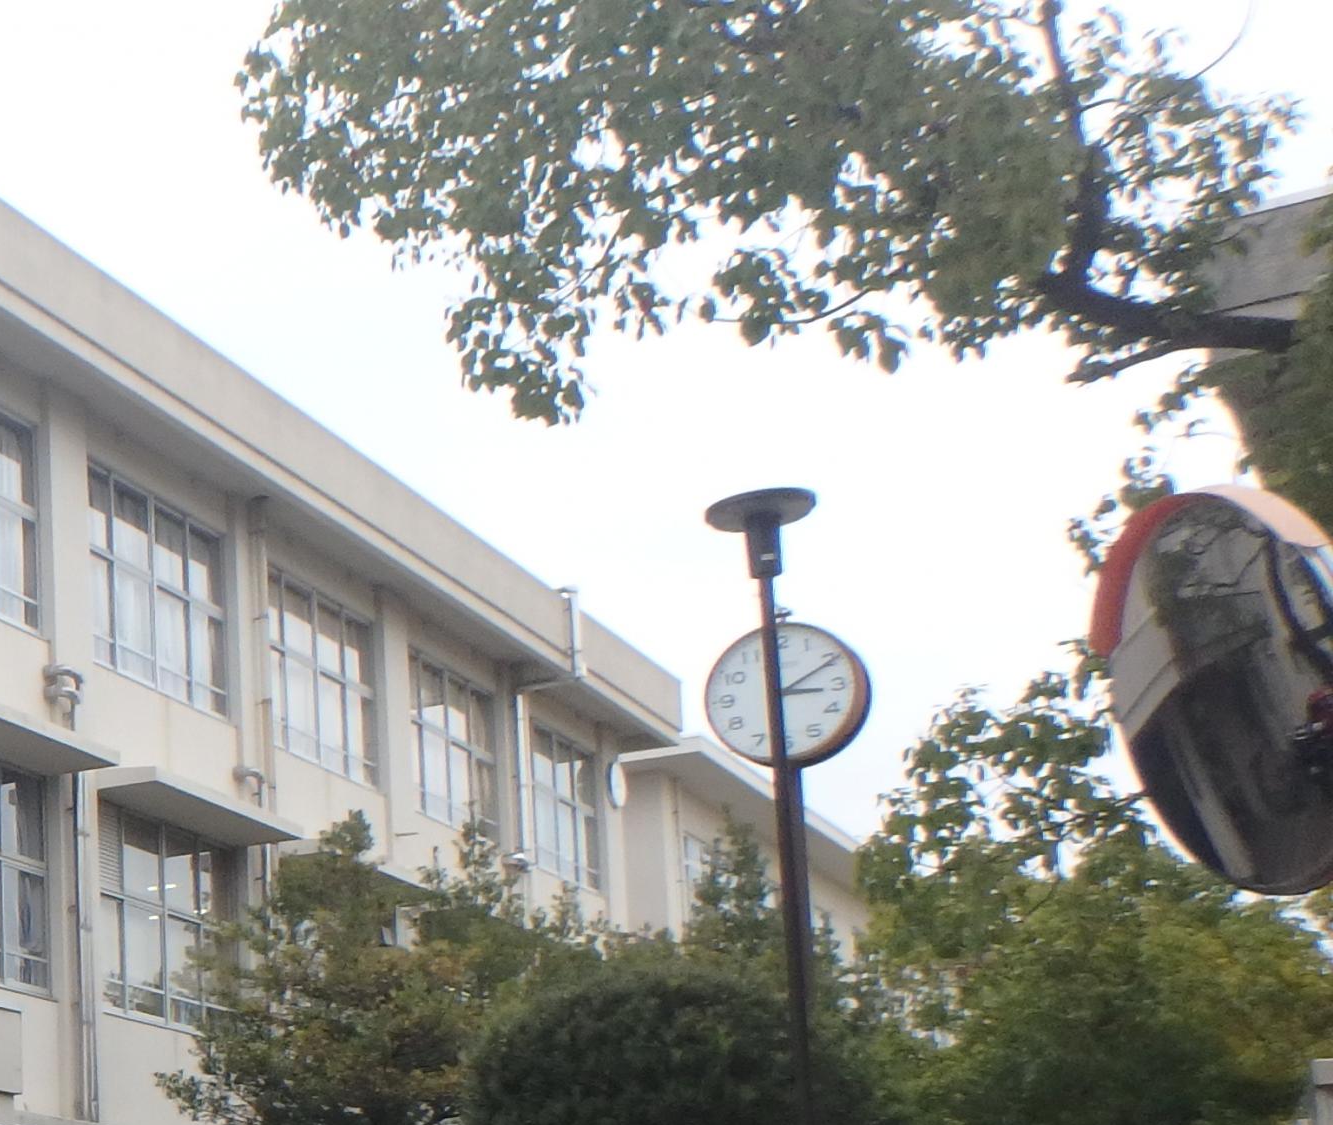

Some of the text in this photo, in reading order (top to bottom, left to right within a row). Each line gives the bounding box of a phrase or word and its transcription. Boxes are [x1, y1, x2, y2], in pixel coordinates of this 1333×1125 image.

[803, 638, 810, 651] 1
[742, 650, 759, 664] 11
[822, 652, 837, 667] 2
[724, 672, 746, 686] 10
[830, 676, 845, 691] 3
[718, 694, 735, 709] 9
[824, 702, 841, 714] 4
[728, 716, 744, 730] 8
[806, 722, 821, 737] 5
[750, 734, 765, 747] 7
